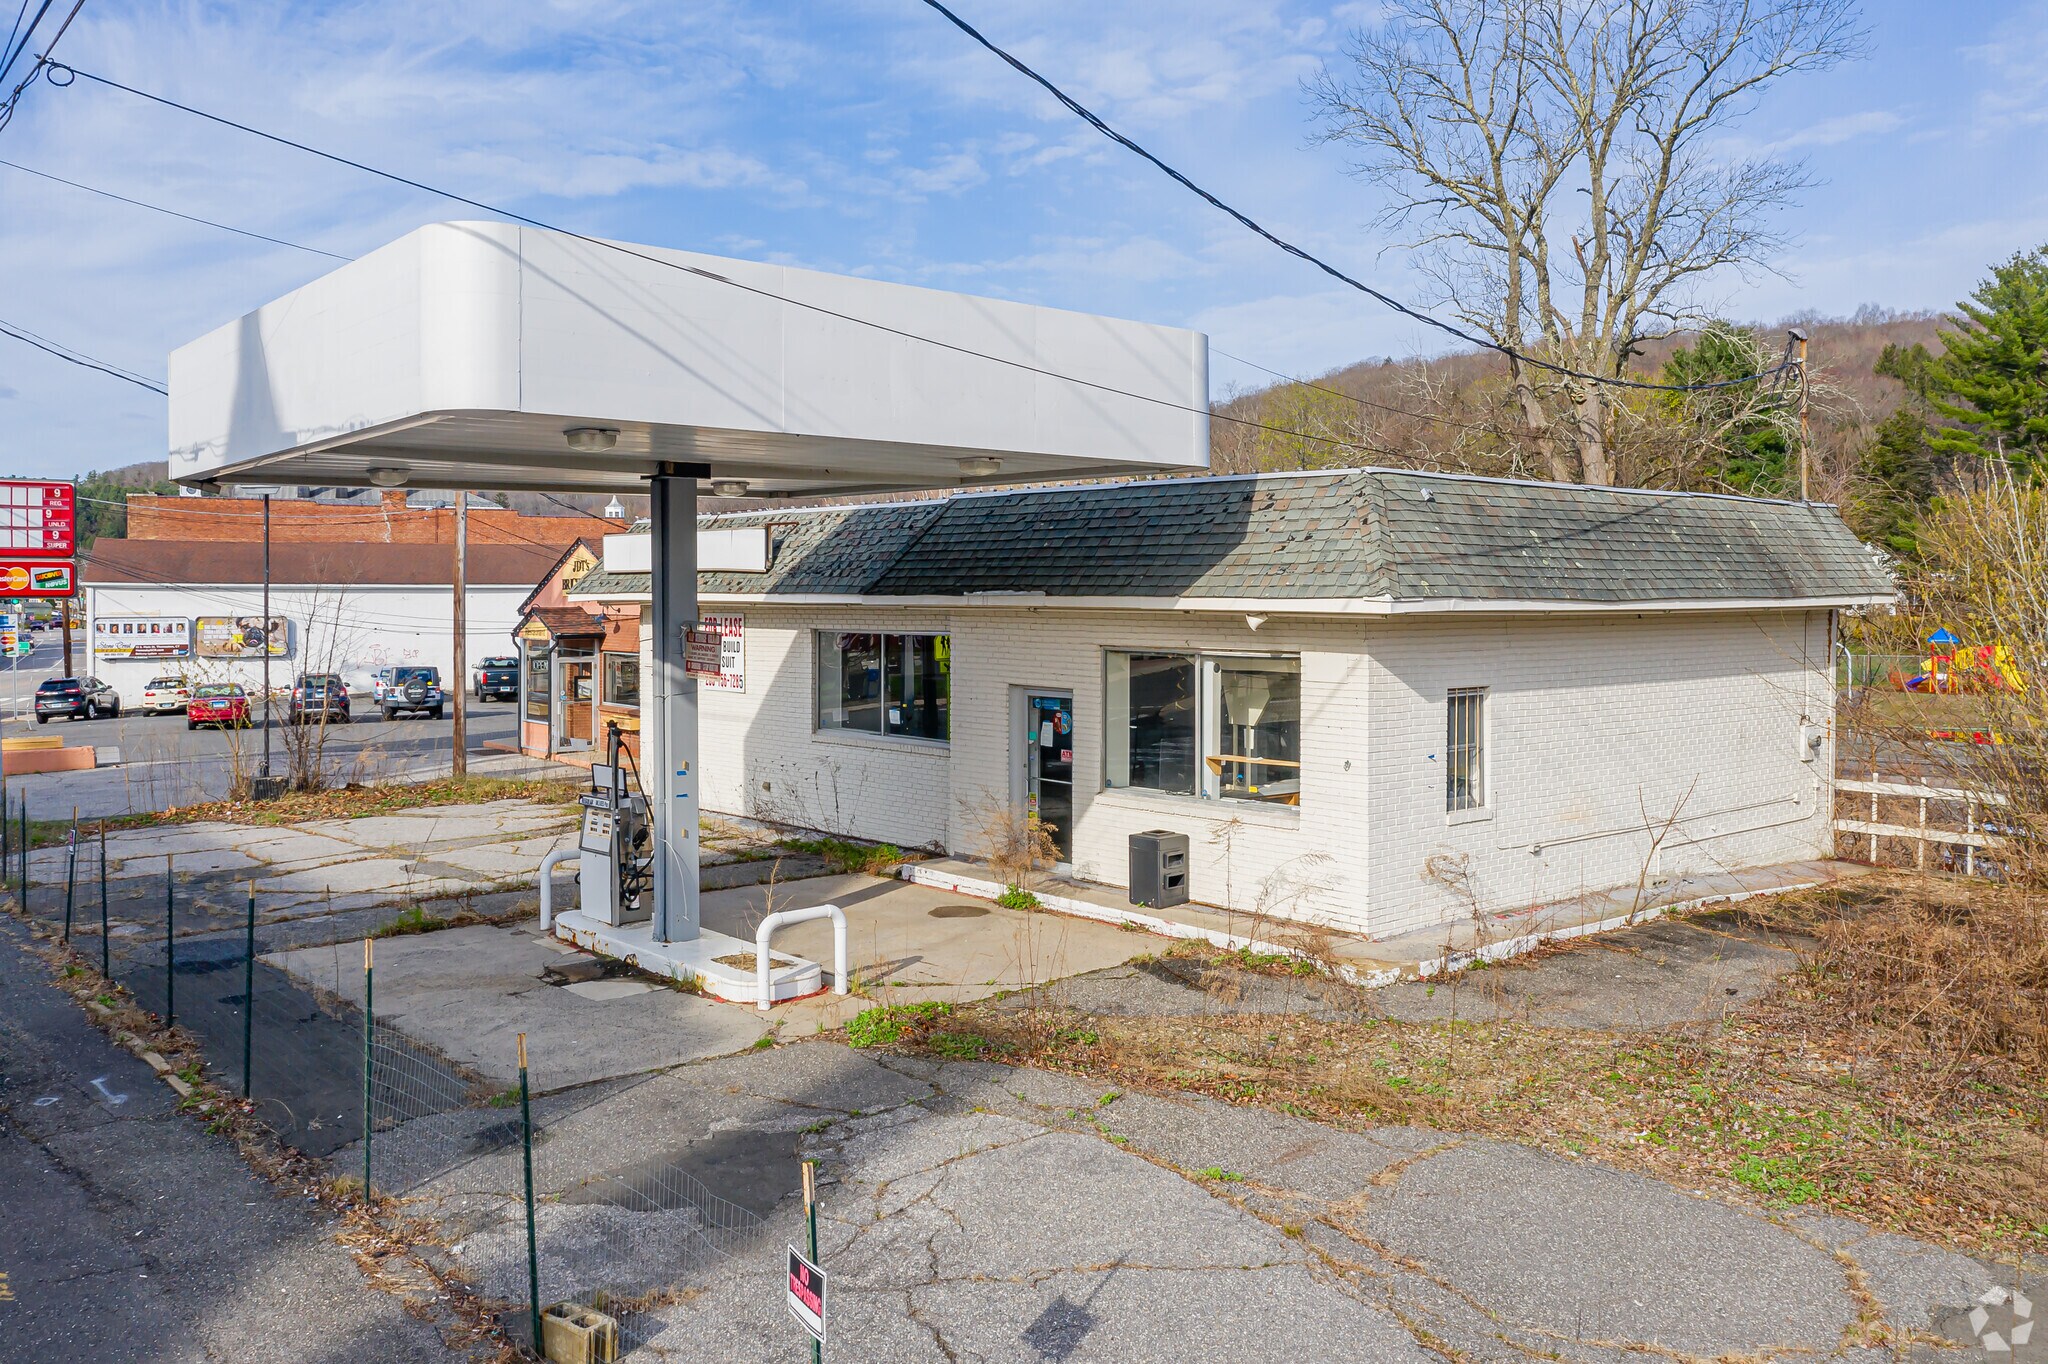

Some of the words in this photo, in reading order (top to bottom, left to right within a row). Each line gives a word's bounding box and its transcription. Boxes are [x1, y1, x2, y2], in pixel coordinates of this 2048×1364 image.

[54, 488, 61, 498] 9
[45, 509, 52, 518] 9
[52, 530, 59, 540] 9
[45, 579, 68, 588] NOVUS
[721, 617, 743, 638] LEASE
[691, 644, 716, 653] WARNING
[723, 641, 741, 653] BUILD
[533, 660, 548, 670] OPEN
[721, 656, 736, 668] SUIT
[799, 1263, 810, 1287] NO
